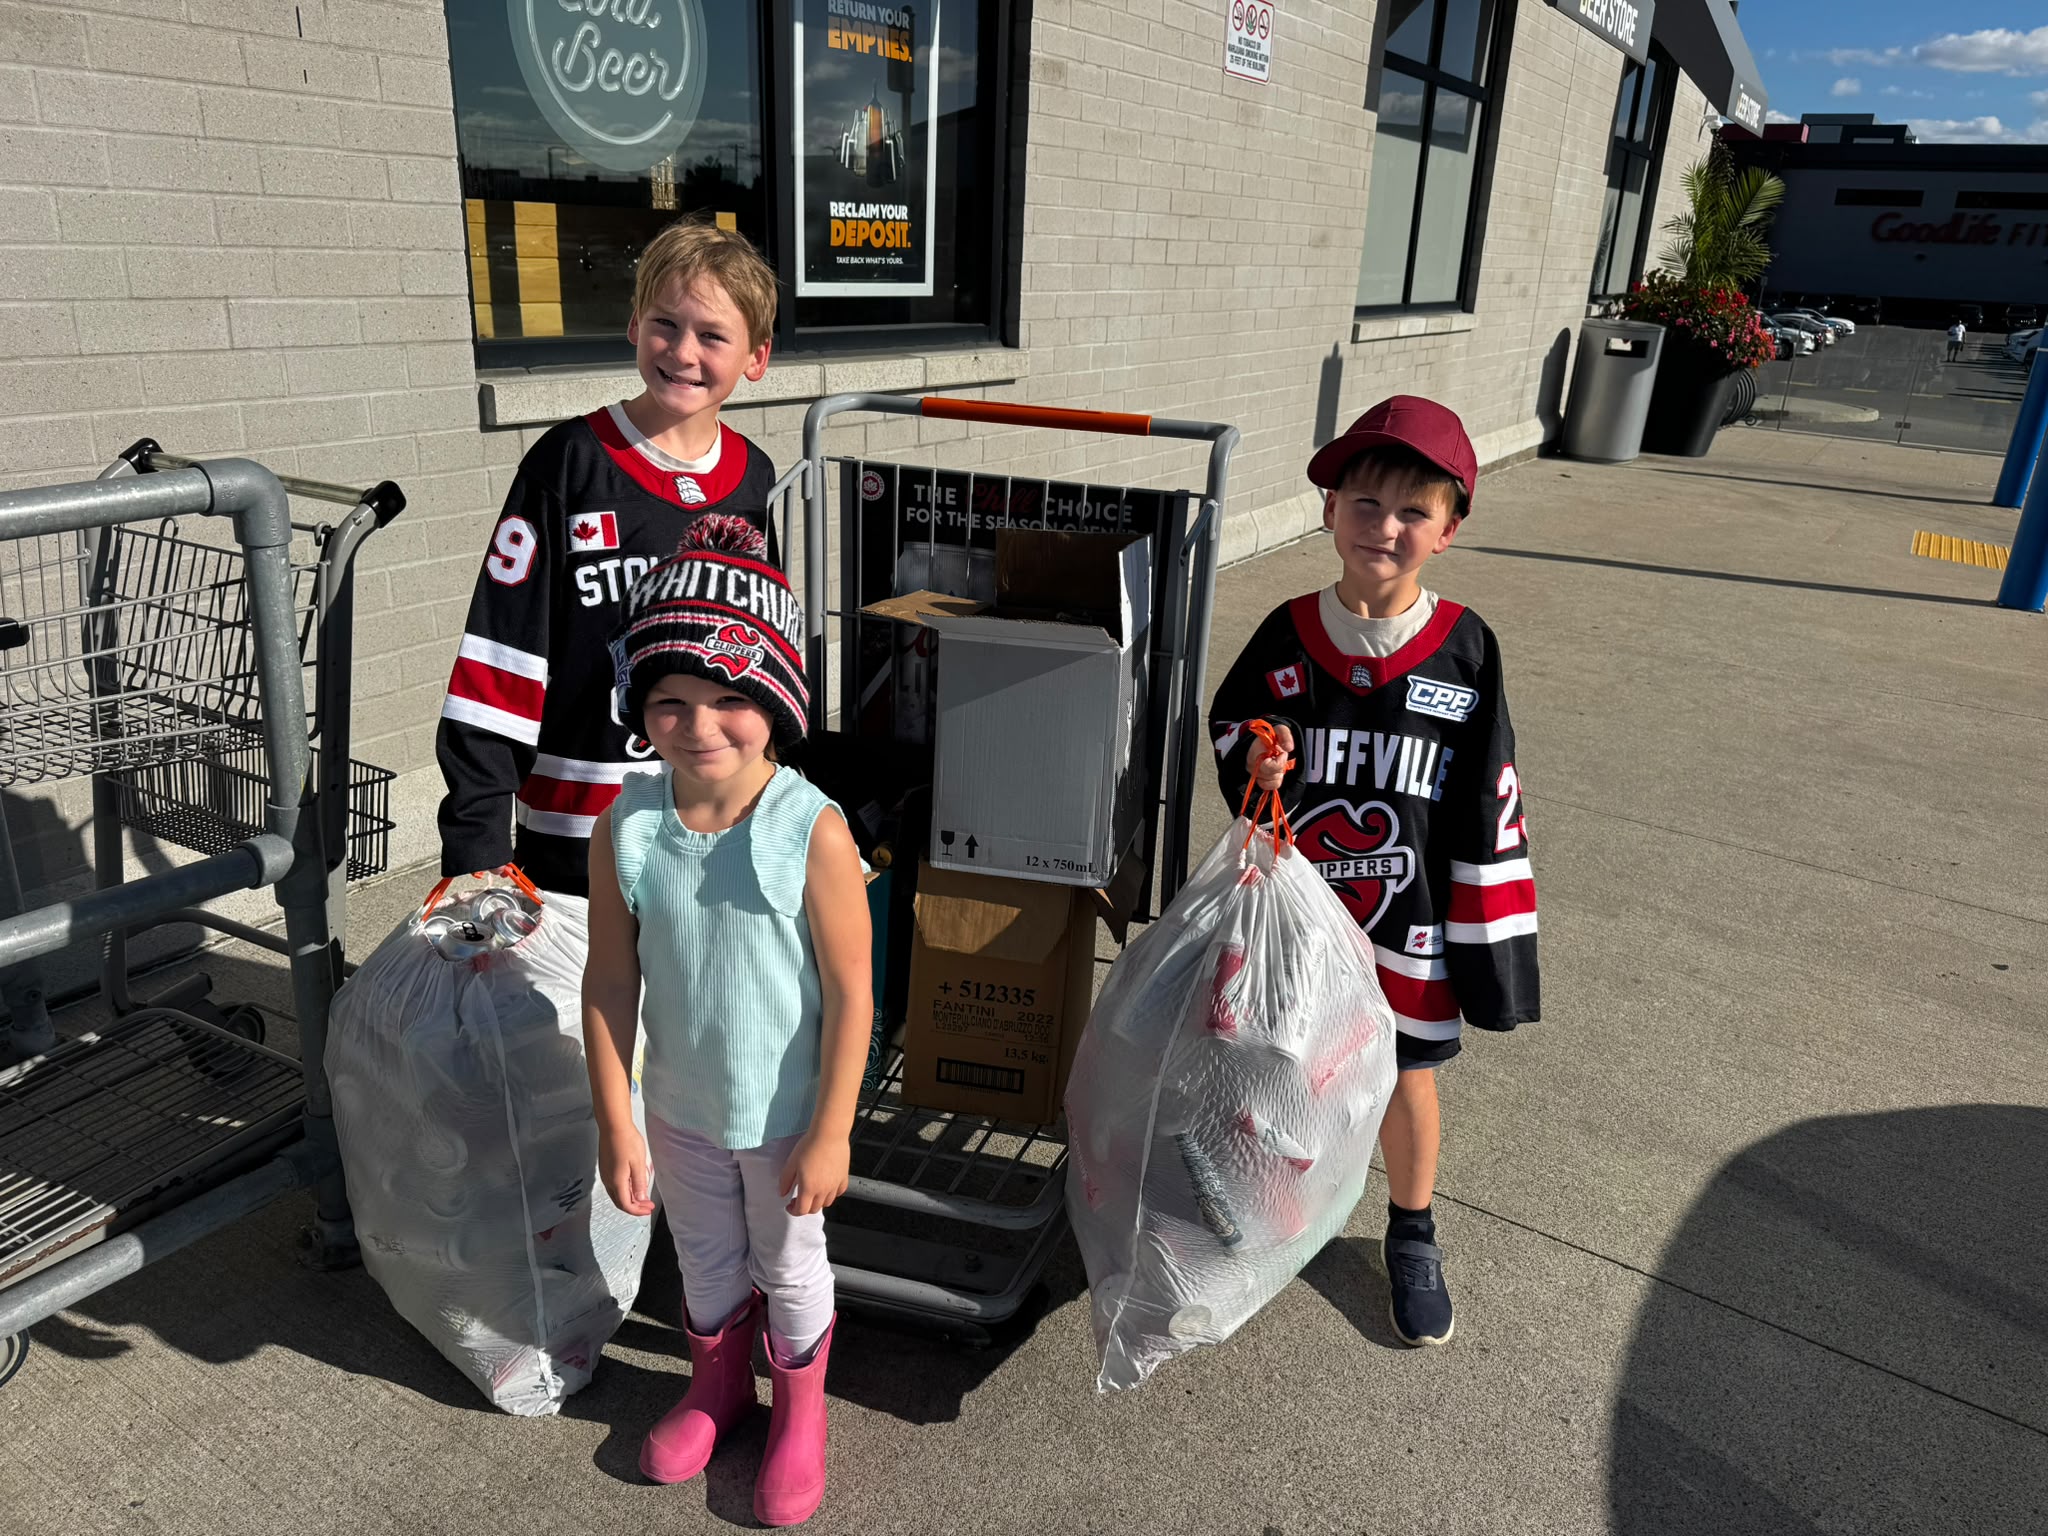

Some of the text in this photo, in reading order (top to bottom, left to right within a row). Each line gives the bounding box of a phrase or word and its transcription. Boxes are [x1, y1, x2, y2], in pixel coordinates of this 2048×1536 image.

[828, 0, 910, 29] RETURN YOUR
[1607, 0, 1638, 47] STORE
[827, 15, 912, 63] EMPTIES.
[552, 21, 687, 100] Beer
[830, 201, 908, 220] RECLAIM YOUR
[830, 218, 911, 248] DEPOSIT.
[836, 256, 850, 264] TAKE
[850, 256, 865, 264] BACK
[865, 256, 886, 265] WHAT'S
[906, 507, 942, 527] FOR
[946, 510, 981, 529] THE
[914, 484, 957, 506] THE
[1041, 497, 1133, 523] CHOICE
[486, 514, 538, 587] 9
[575, 556, 658, 607] STO
[629, 560, 804, 652] WHITCHUR
[713, 640, 758, 660] CLIPPERS
[1411, 682, 1474, 713] CPP
[1494, 762, 1528, 854] 2
[1025, 856, 1097, 873] 12 x 750mL
[959, 980, 1036, 1007] 512335
[933, 999, 1055, 1025] FANTINI 2022
